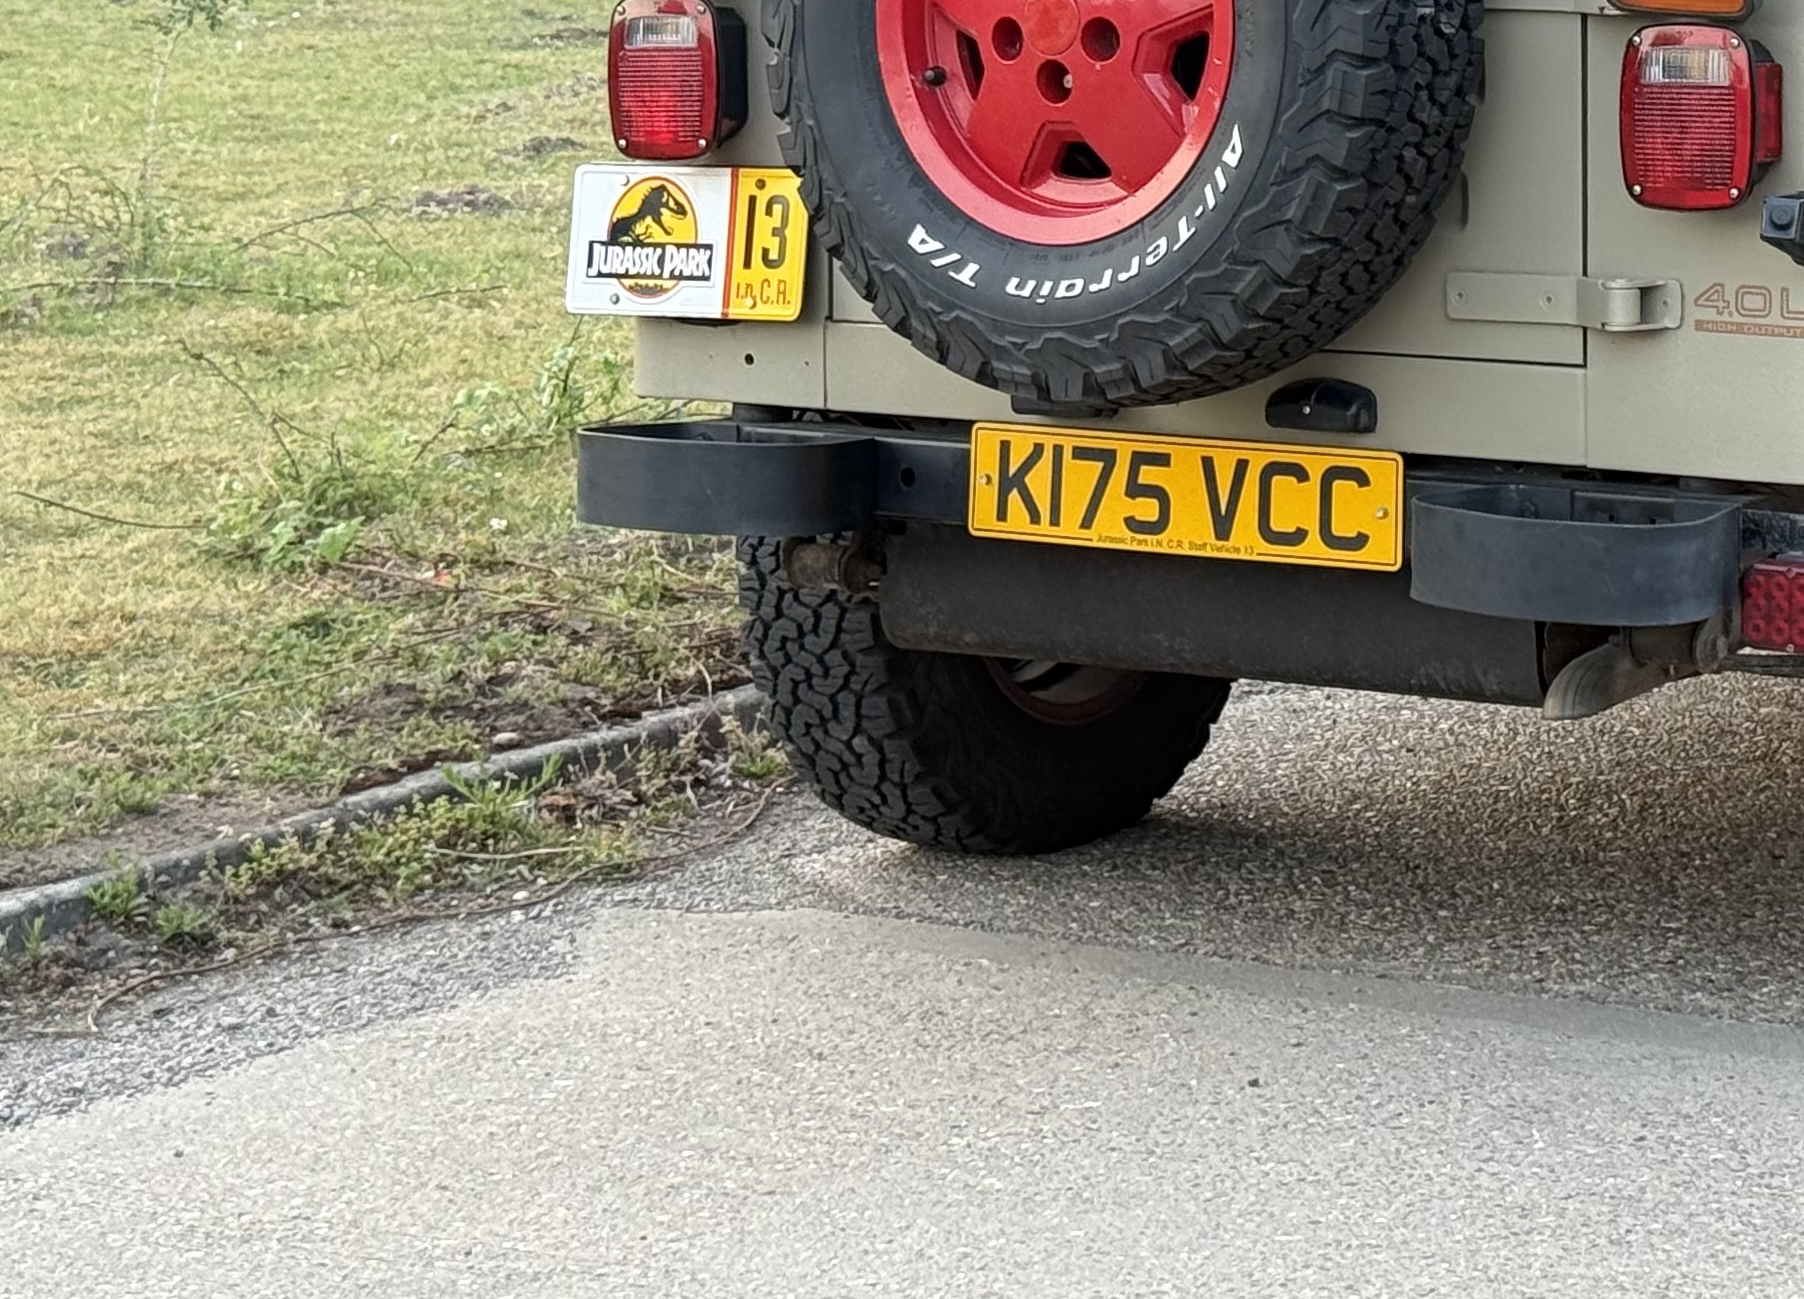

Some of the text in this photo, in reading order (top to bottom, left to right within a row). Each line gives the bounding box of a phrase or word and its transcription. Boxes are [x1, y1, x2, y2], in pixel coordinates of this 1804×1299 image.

[742, 193, 791, 271] 13
[906, 122, 1246, 305] All-Terrain T/A
[587, 242, 712, 278] JURASSIC PARK
[1702, 320, 1803, 337] HIGH OUTPUT
[996, 439, 1373, 552] K175 VCC
[1096, 533, 1129, 546] Jurassic
[1130, 535, 1149, 547] Park
[1187, 539, 1208, 552] Staff
[1208, 541, 1242, 555] Vehicle
[1244, 544, 1256, 556] 13
